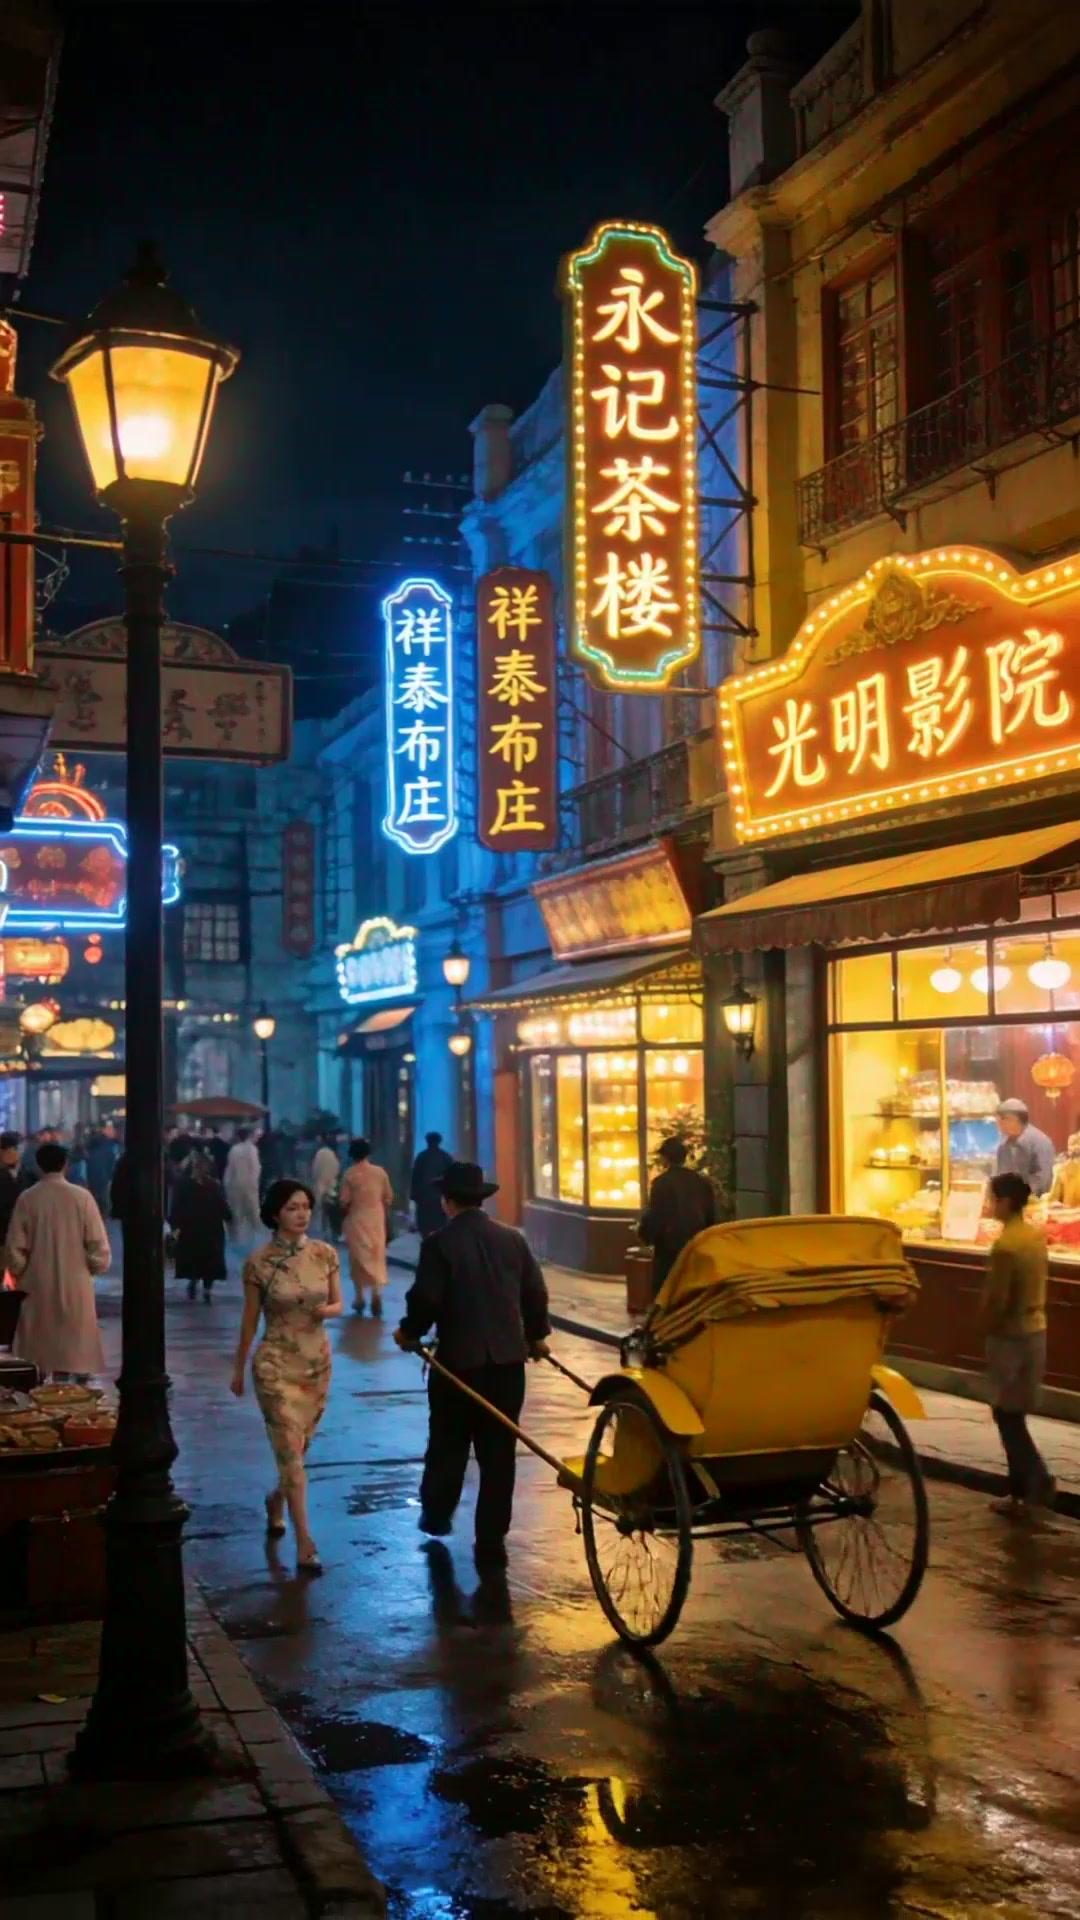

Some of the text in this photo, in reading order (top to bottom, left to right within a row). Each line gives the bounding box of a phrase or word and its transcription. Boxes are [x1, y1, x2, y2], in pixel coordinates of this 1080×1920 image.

[591, 268, 681, 639] 永记茶楼
[394, 608, 450, 825] 祥泰布庄
[487, 584, 547, 836] 祥泰布庄
[764, 628, 1073, 798] 光明影院
